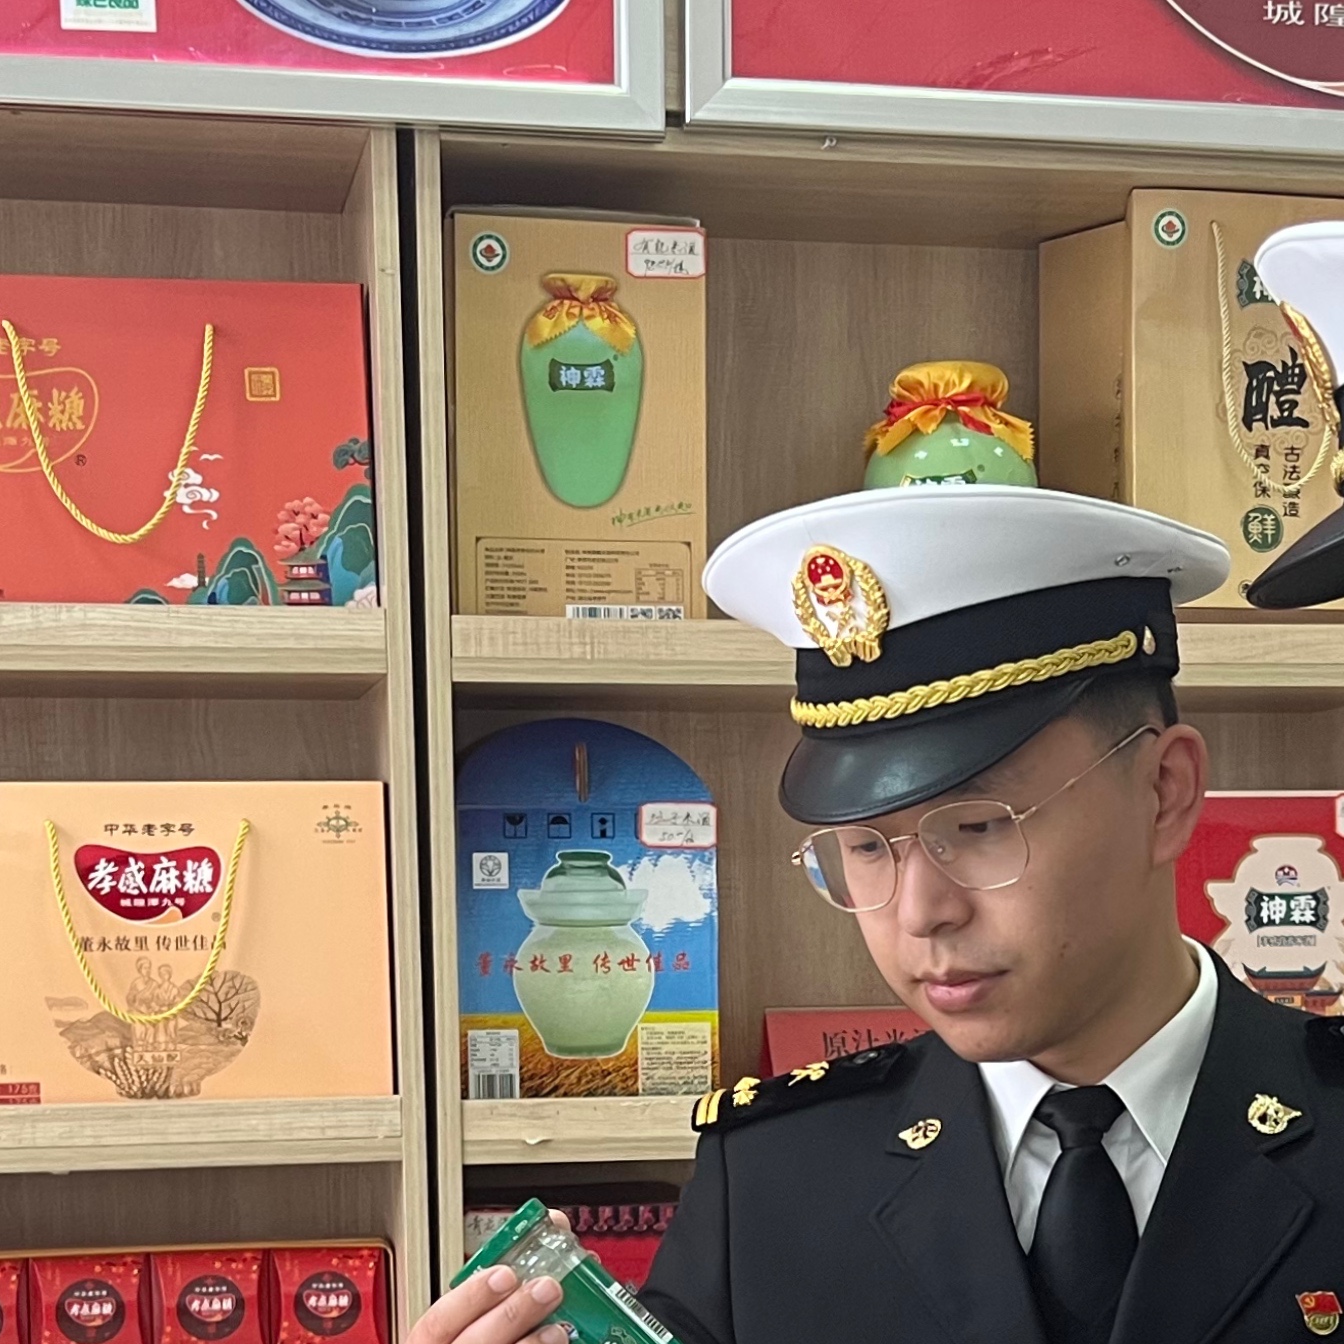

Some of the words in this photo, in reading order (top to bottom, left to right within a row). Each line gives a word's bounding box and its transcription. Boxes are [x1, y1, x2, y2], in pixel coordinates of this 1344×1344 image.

[559, 366, 606, 389] 神霖
[104, 822, 195, 838] 中华老字号
[88, 857, 214, 896] 孝感麻糖
[1260, 895, 1317, 924] 神霖
[592, 950, 692, 975] 传世佳品
[822, 1029, 931, 1058] 原汁米
